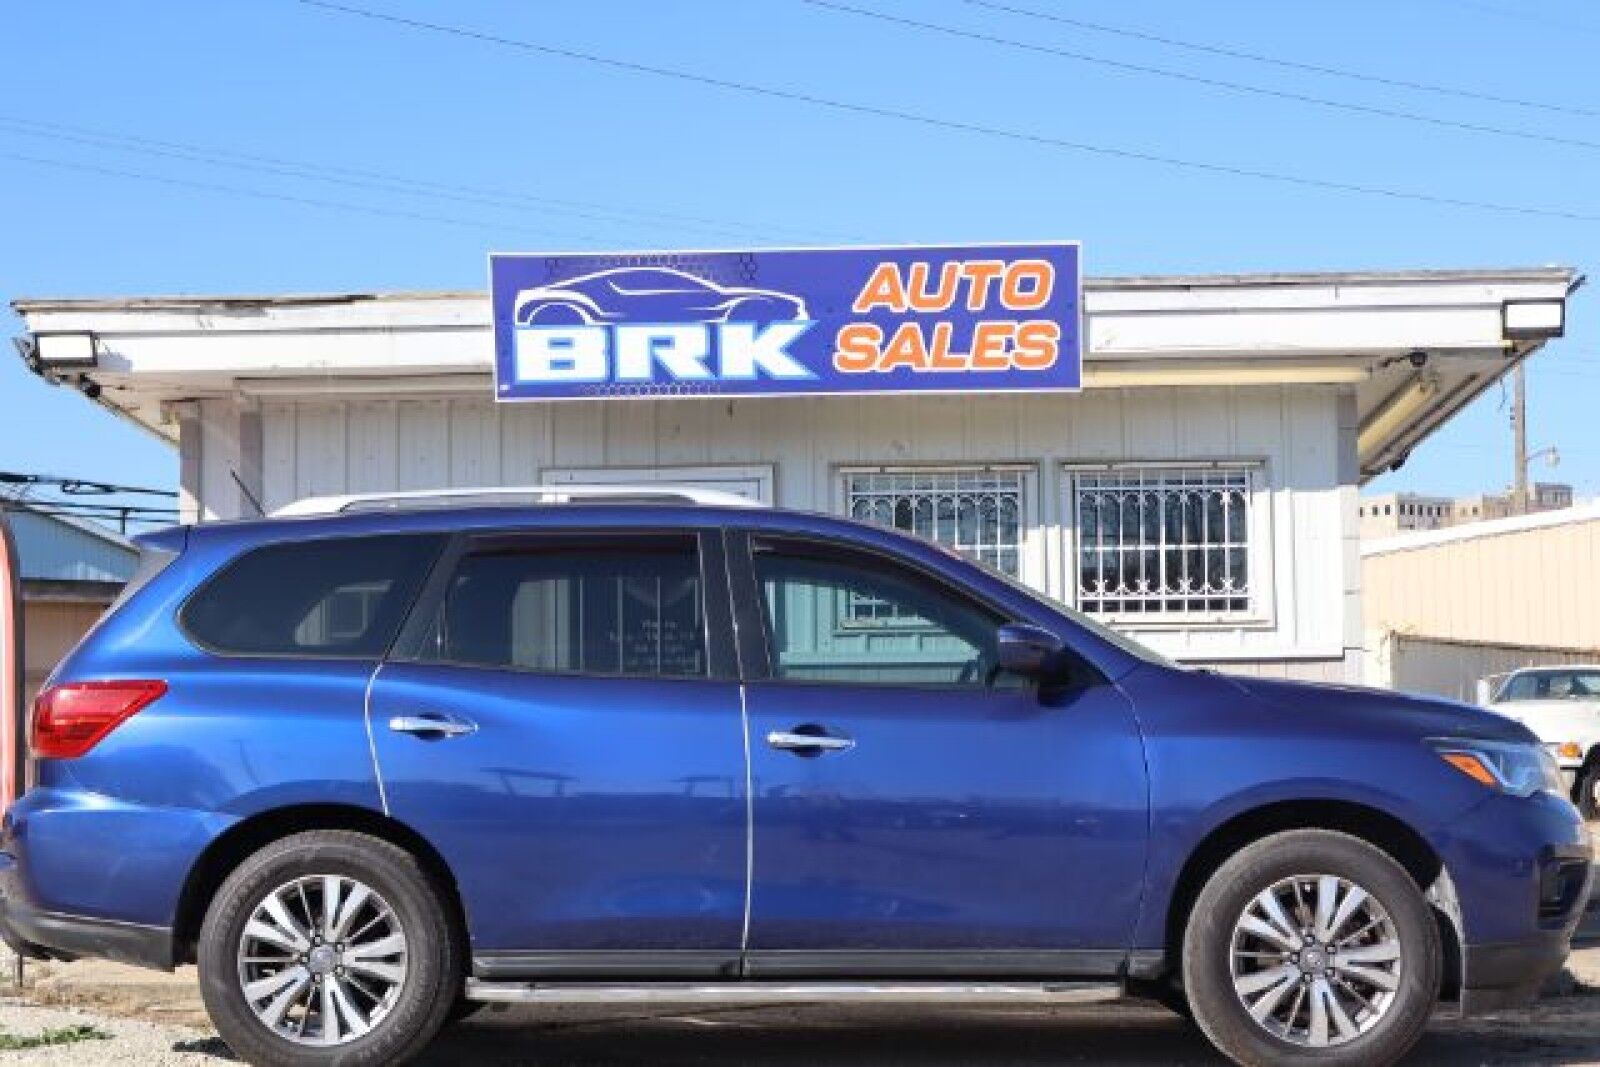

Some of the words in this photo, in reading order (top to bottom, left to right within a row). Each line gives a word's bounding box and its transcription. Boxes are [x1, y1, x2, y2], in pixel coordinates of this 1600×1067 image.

[852, 260, 1056, 313] AUTO
[513, 320, 819, 384] BRK
[832, 320, 1060, 373] SALES
